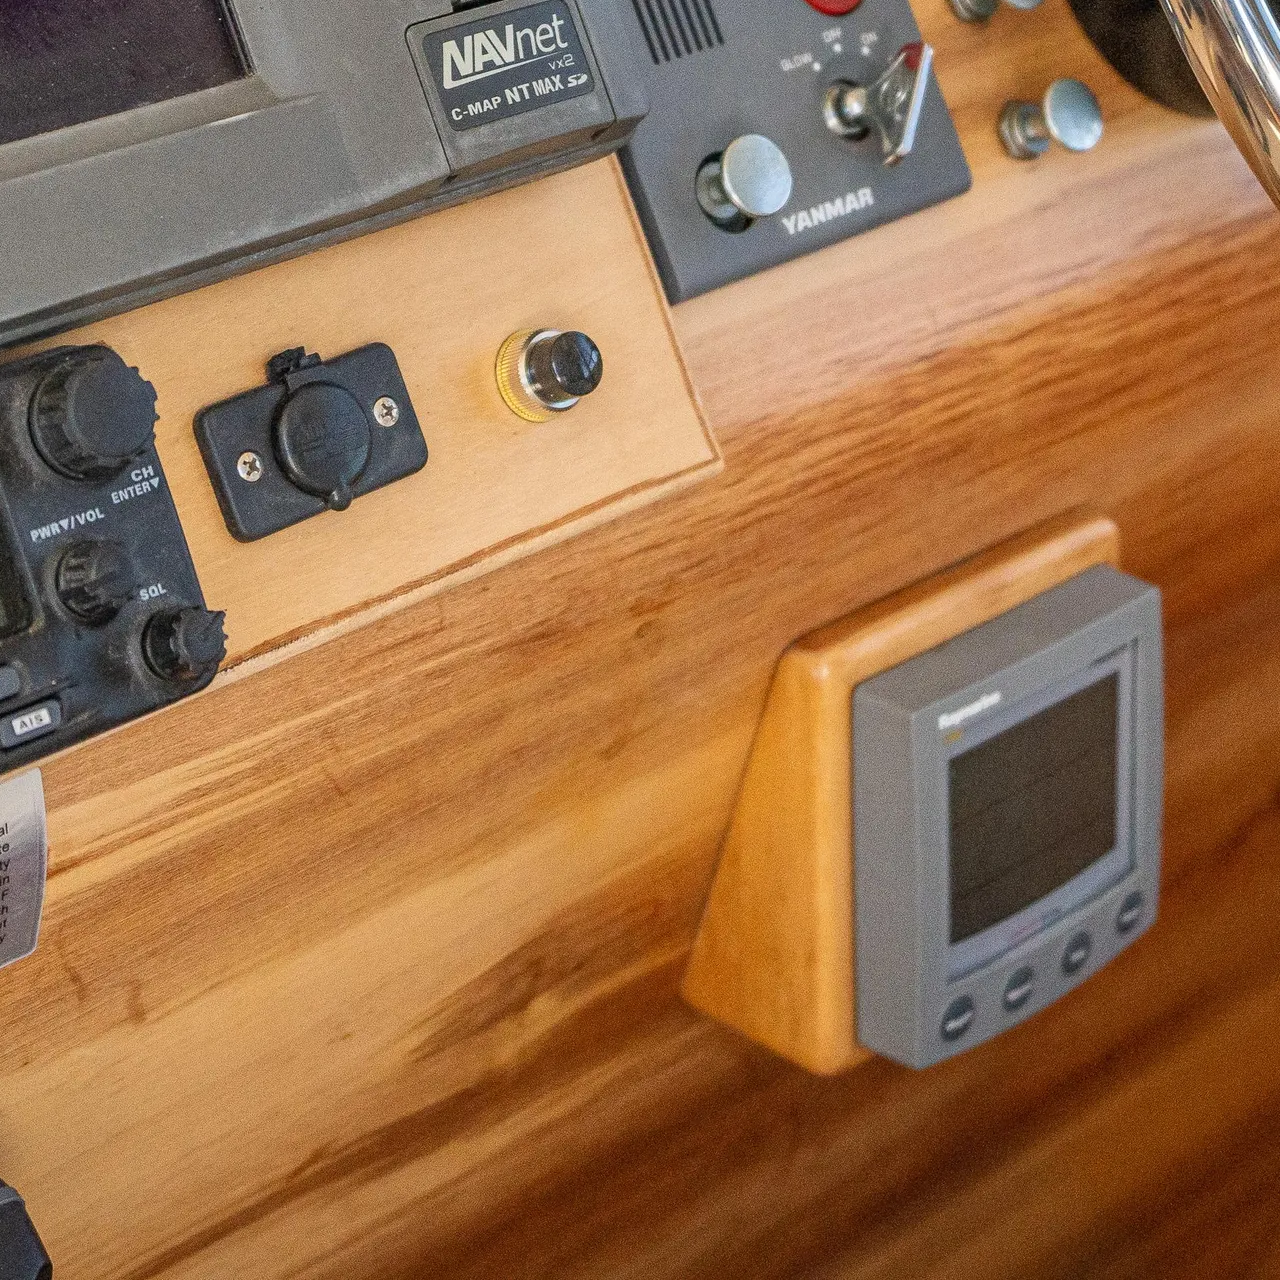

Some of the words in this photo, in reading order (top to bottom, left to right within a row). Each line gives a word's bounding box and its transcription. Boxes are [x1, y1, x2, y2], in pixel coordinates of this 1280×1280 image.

[451, 96, 502, 121] C-MAP
[504, 82, 531, 105] NT
[532, 74, 564, 97] MAX
[782, 187, 874, 236] YANMAR
[131, 465, 155, 482] CH
[139, 583, 168, 602] SQL
[19, 714, 46, 731] AIS
